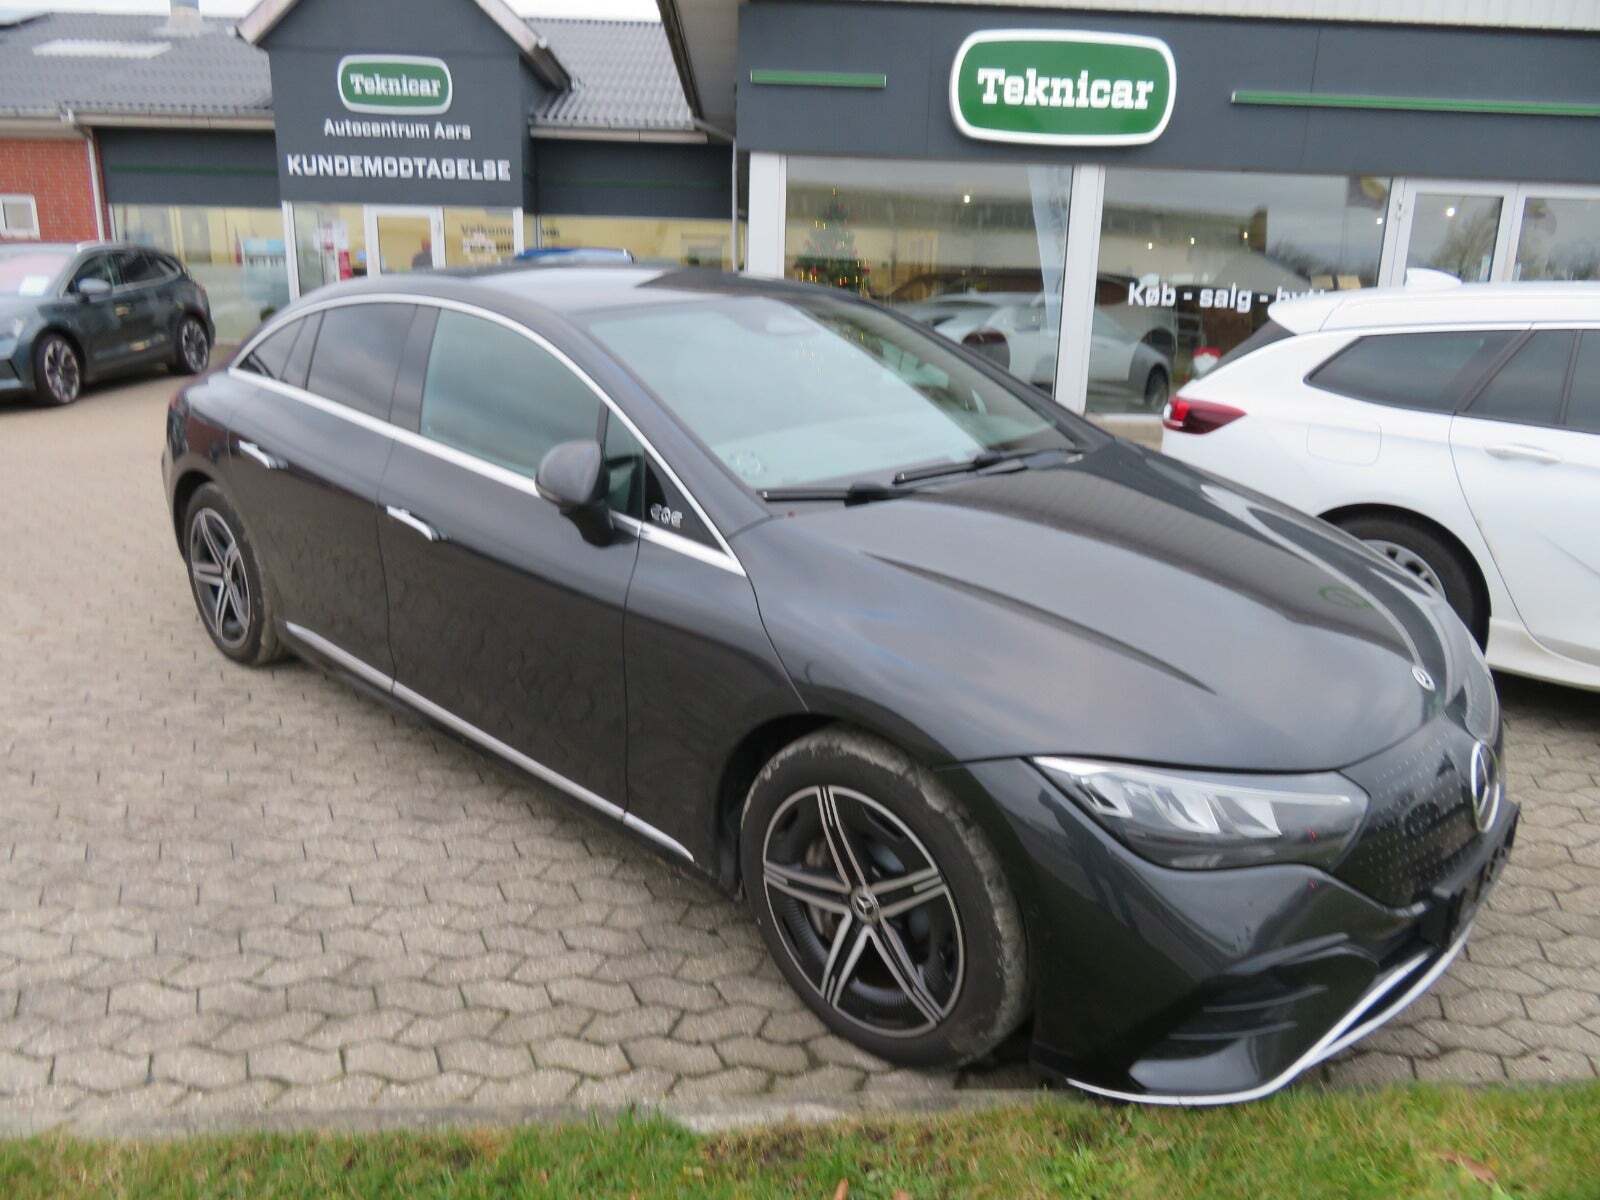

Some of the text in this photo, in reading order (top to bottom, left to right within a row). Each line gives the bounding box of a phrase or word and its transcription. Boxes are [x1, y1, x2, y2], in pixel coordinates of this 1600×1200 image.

[349, 73, 441, 97] Teknicar
[977, 67, 1154, 110] Teknicar
[323, 118, 472, 141] Autocentrum Aars
[287, 153, 511, 182] KUNDEMODTAGELSE
[1127, 282, 1177, 307] Køb
[1199, 282, 1251, 314] salg
